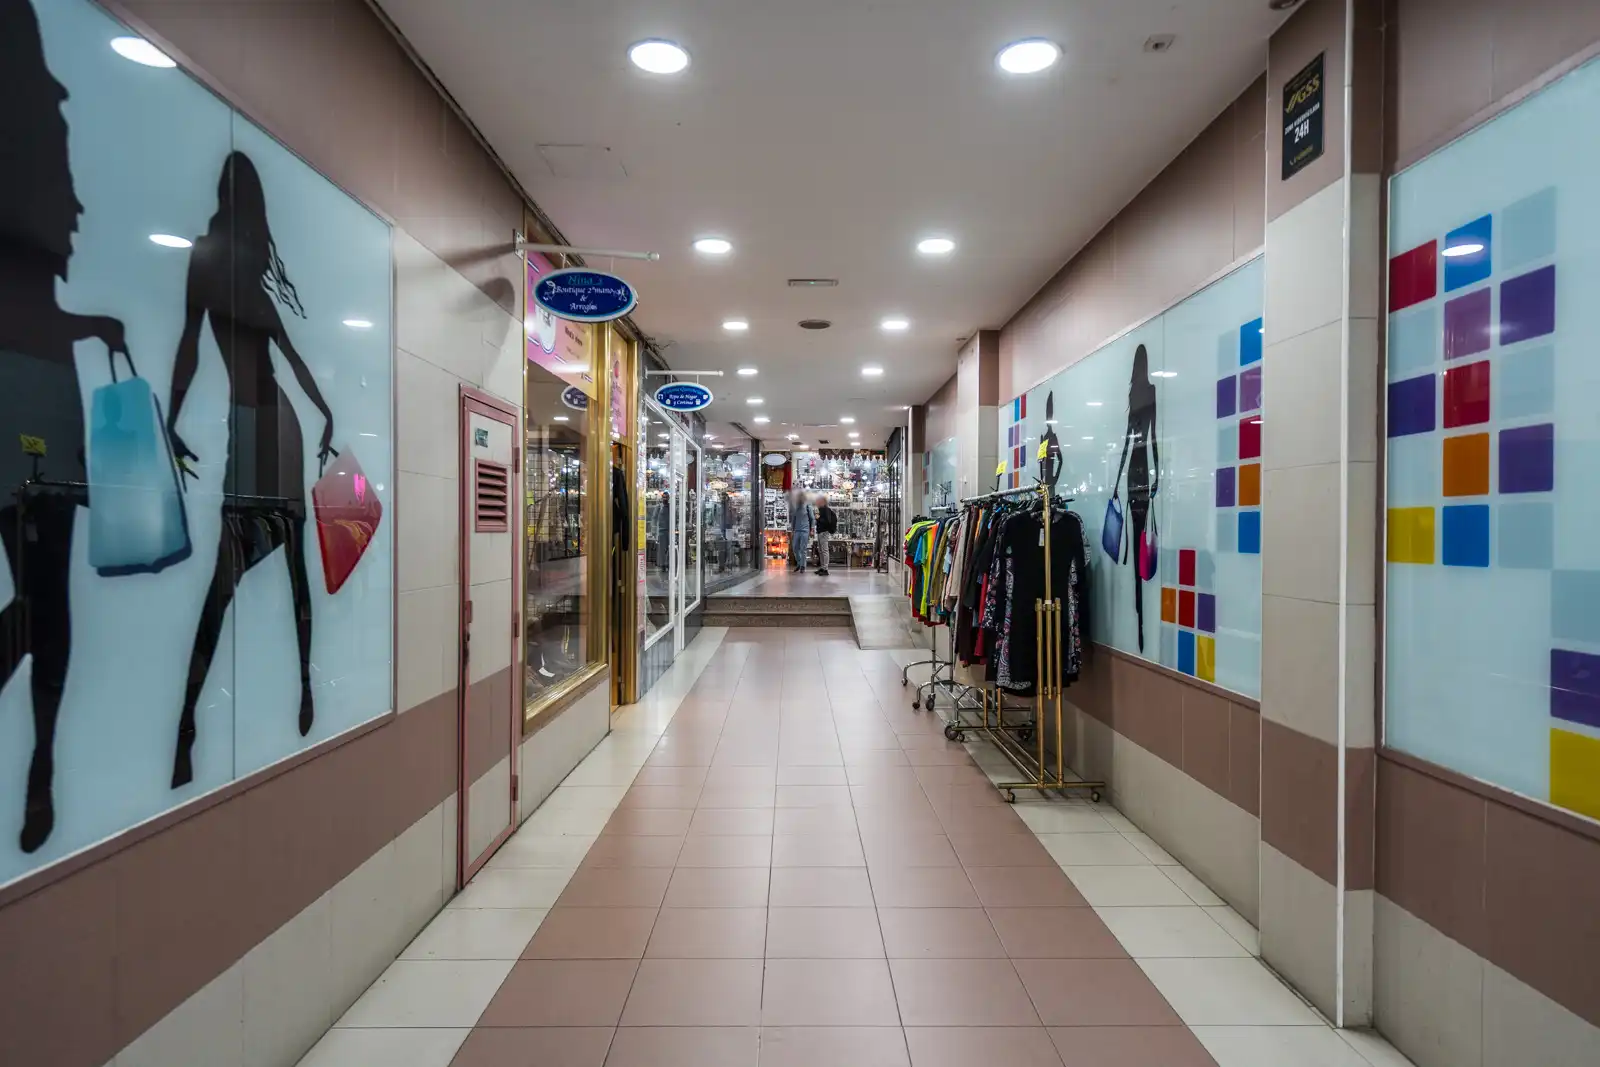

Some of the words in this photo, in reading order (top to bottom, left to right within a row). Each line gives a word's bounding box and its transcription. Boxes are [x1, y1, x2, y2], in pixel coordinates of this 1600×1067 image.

[1294, 119, 1310, 143] 24H
[556, 285, 586, 296] Boutique
[580, 294, 589, 302] &
[569, 301, 598, 313] Arreglos
